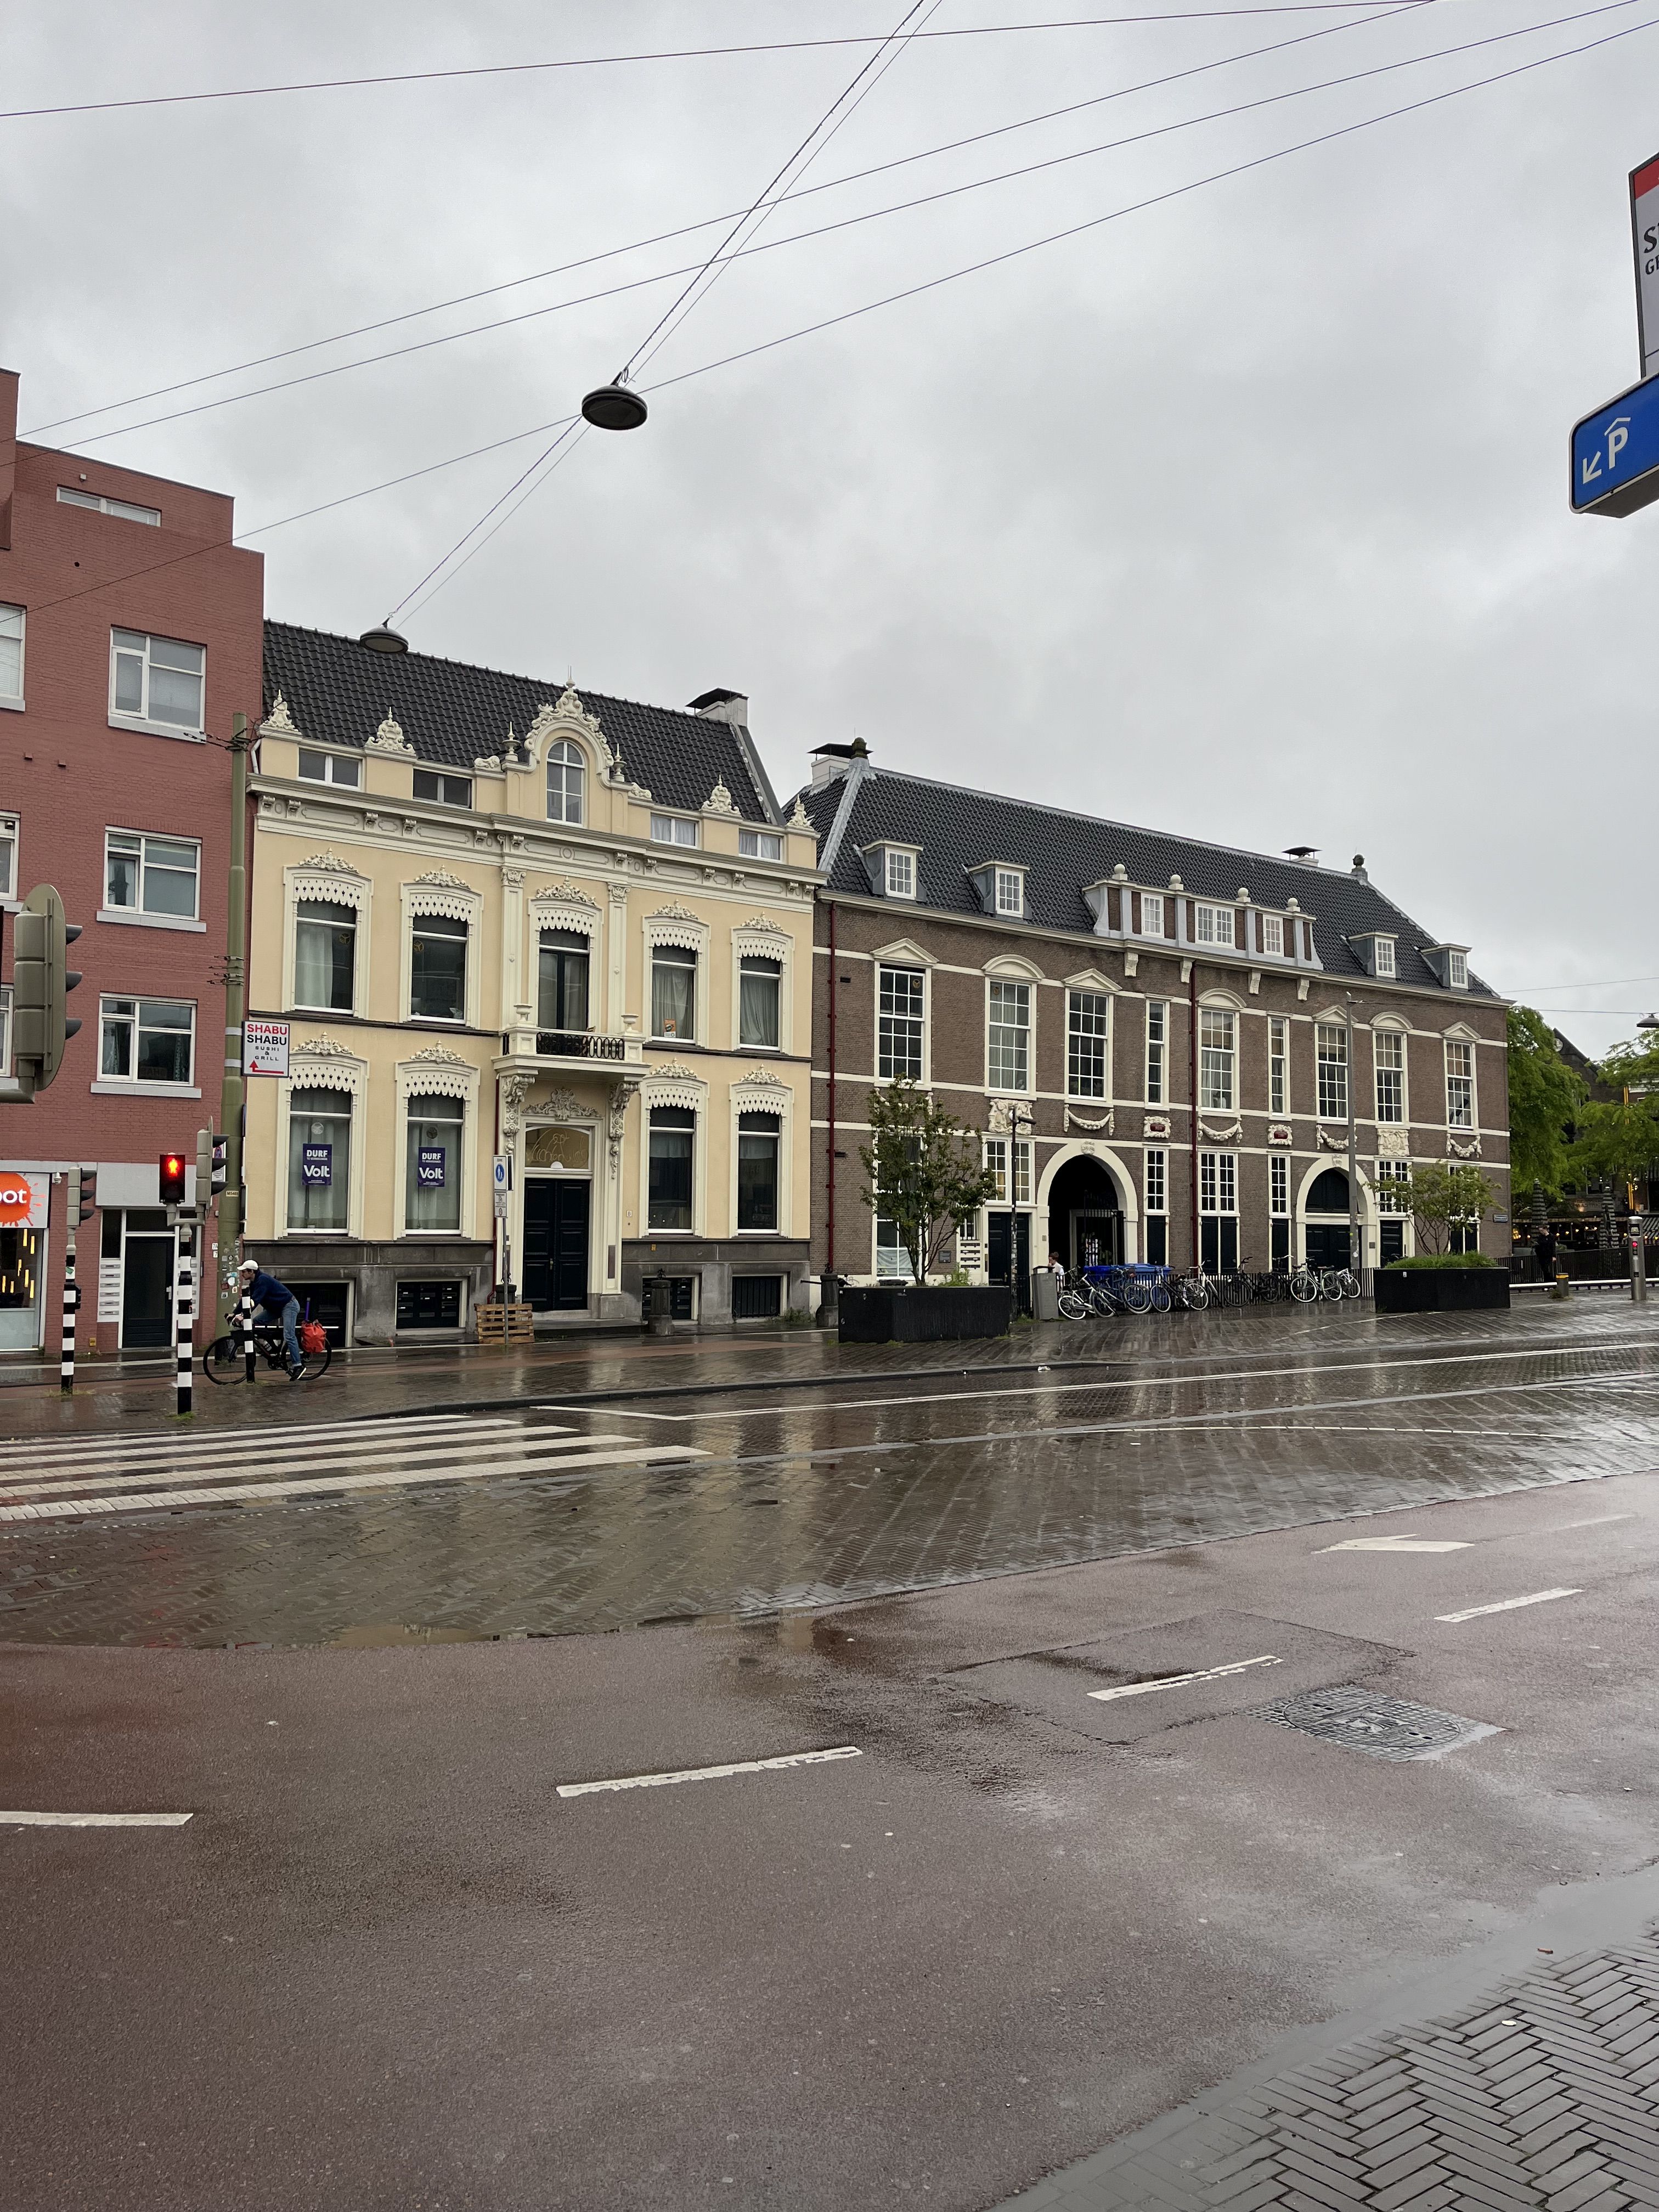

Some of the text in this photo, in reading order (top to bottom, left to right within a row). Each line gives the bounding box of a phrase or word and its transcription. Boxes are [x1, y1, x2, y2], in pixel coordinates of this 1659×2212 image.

[1643, 223, 1659, 253] S
[1609, 427, 1628, 470] P
[247, 1024, 287, 1035] SHABU
[247, 1035, 286, 1045] SHABU
[303, 1165, 330, 1177] Volt
[419, 1167, 443, 1180] Volt
[0, 1189, 27, 1204] ot
